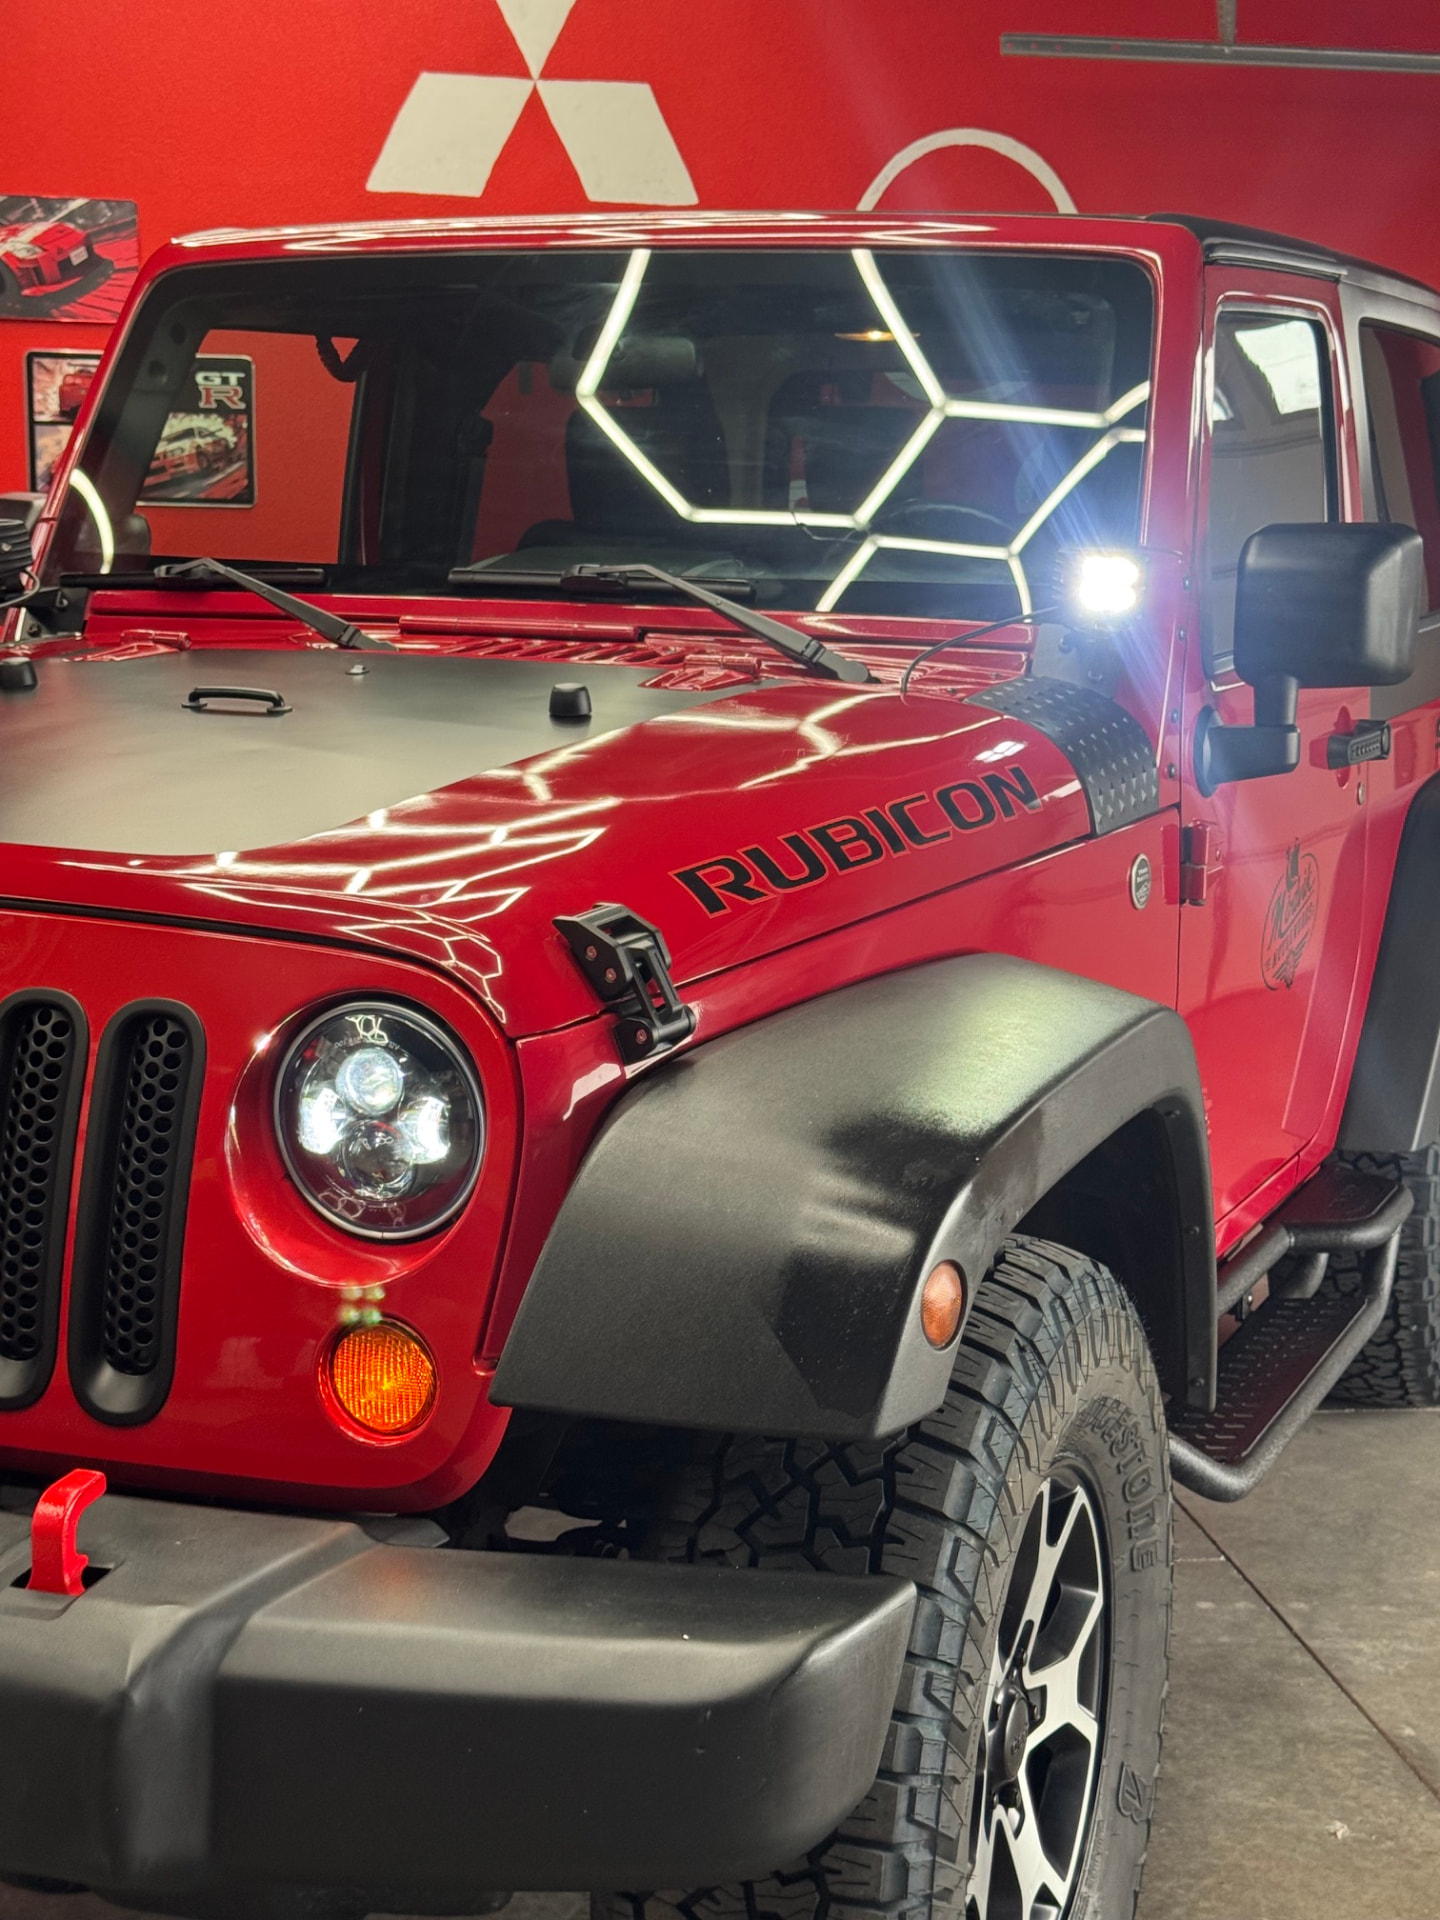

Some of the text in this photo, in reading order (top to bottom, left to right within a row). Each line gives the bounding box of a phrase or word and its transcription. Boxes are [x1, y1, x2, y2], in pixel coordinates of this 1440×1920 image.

[195, 371, 246, 386] GT
[198, 385, 246, 409] R
[670, 765, 1042, 917] RUBICON
